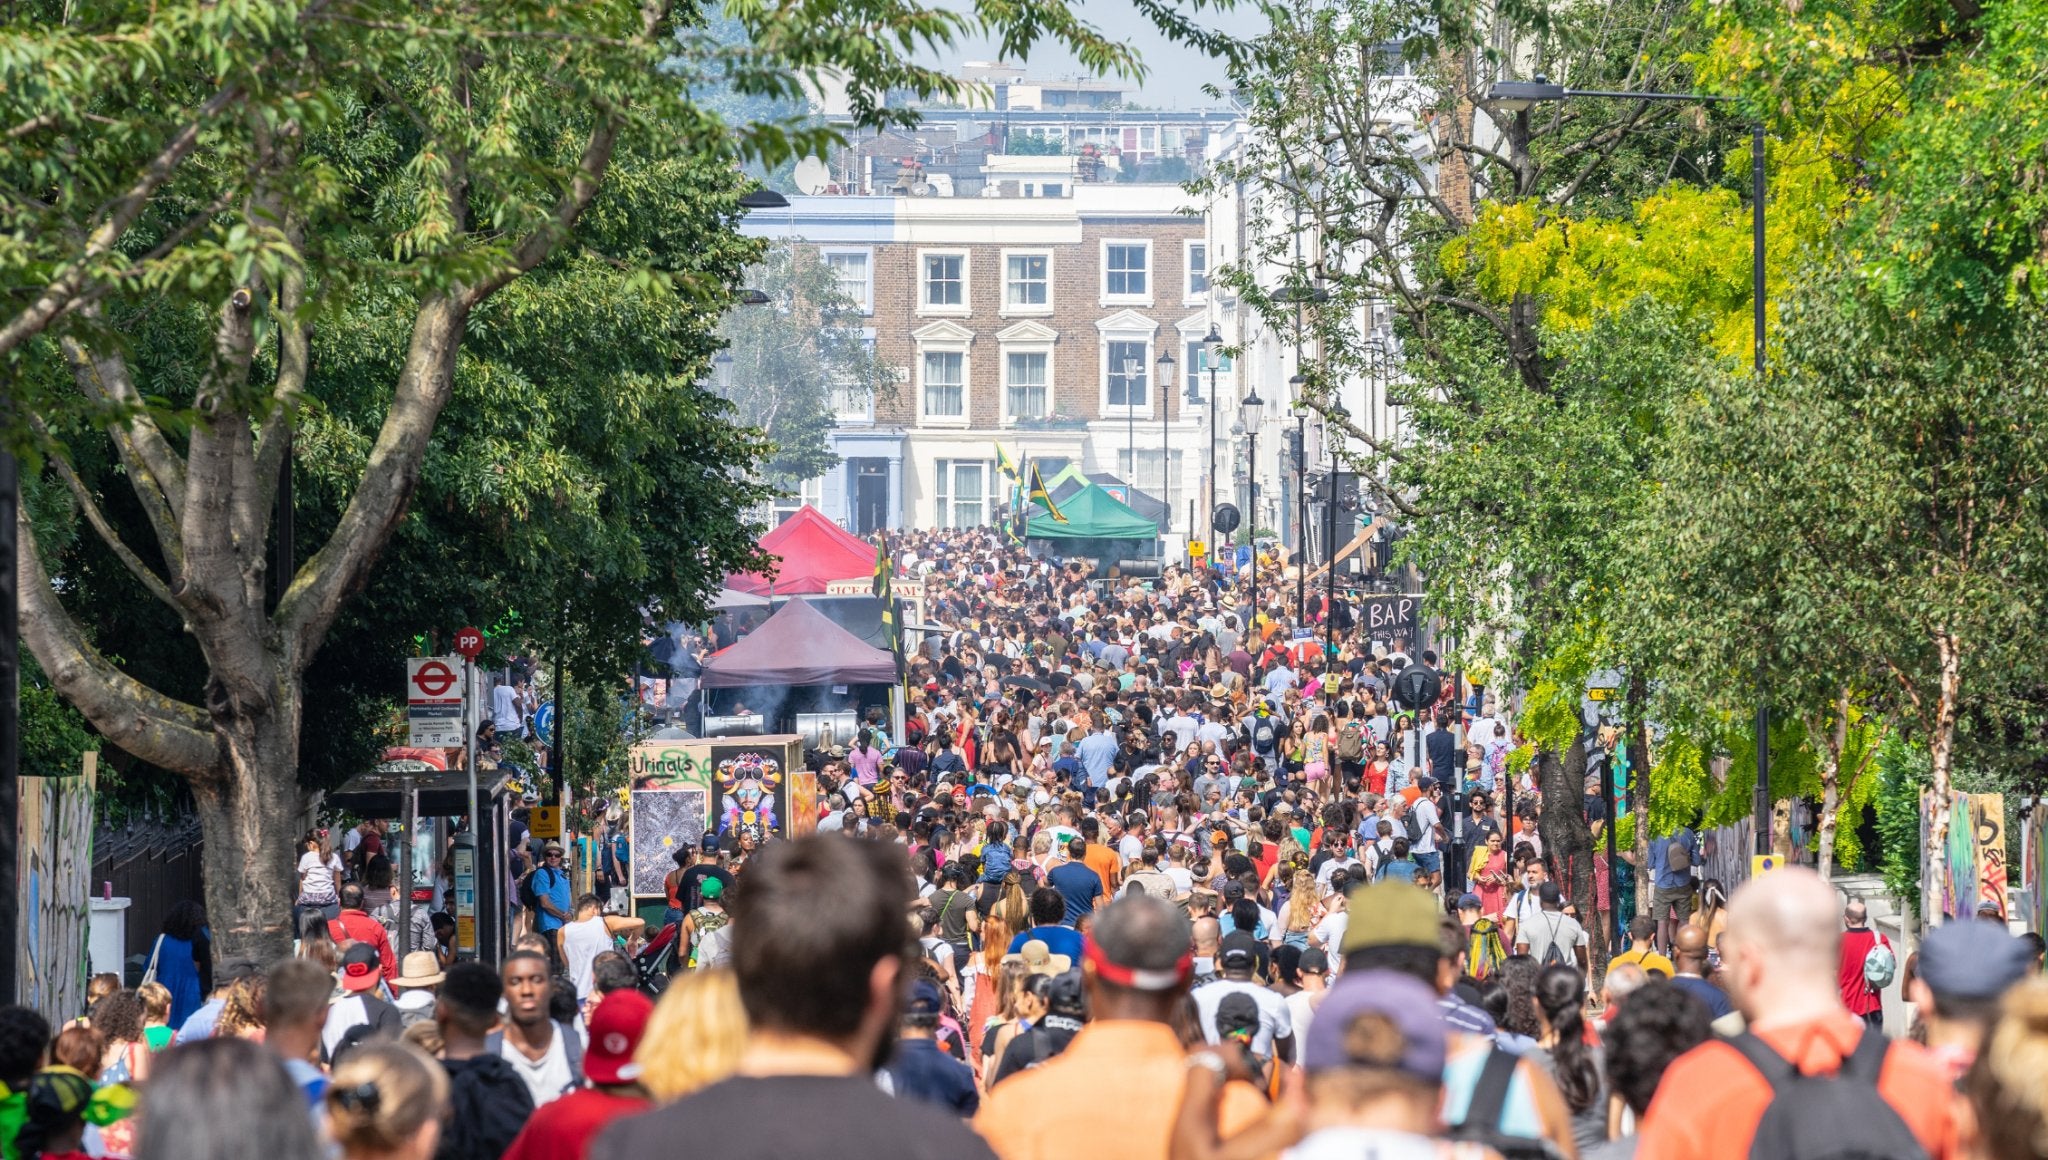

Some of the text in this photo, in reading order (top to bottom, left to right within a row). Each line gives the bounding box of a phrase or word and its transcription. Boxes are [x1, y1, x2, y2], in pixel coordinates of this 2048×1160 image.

[837, 586, 916, 596] ICE CAM
[1371, 599, 1412, 628] BAR
[1371, 627, 1414, 641] THIS WAY
[460, 636, 478, 648] PP
[633, 756, 692, 773] Urinals
